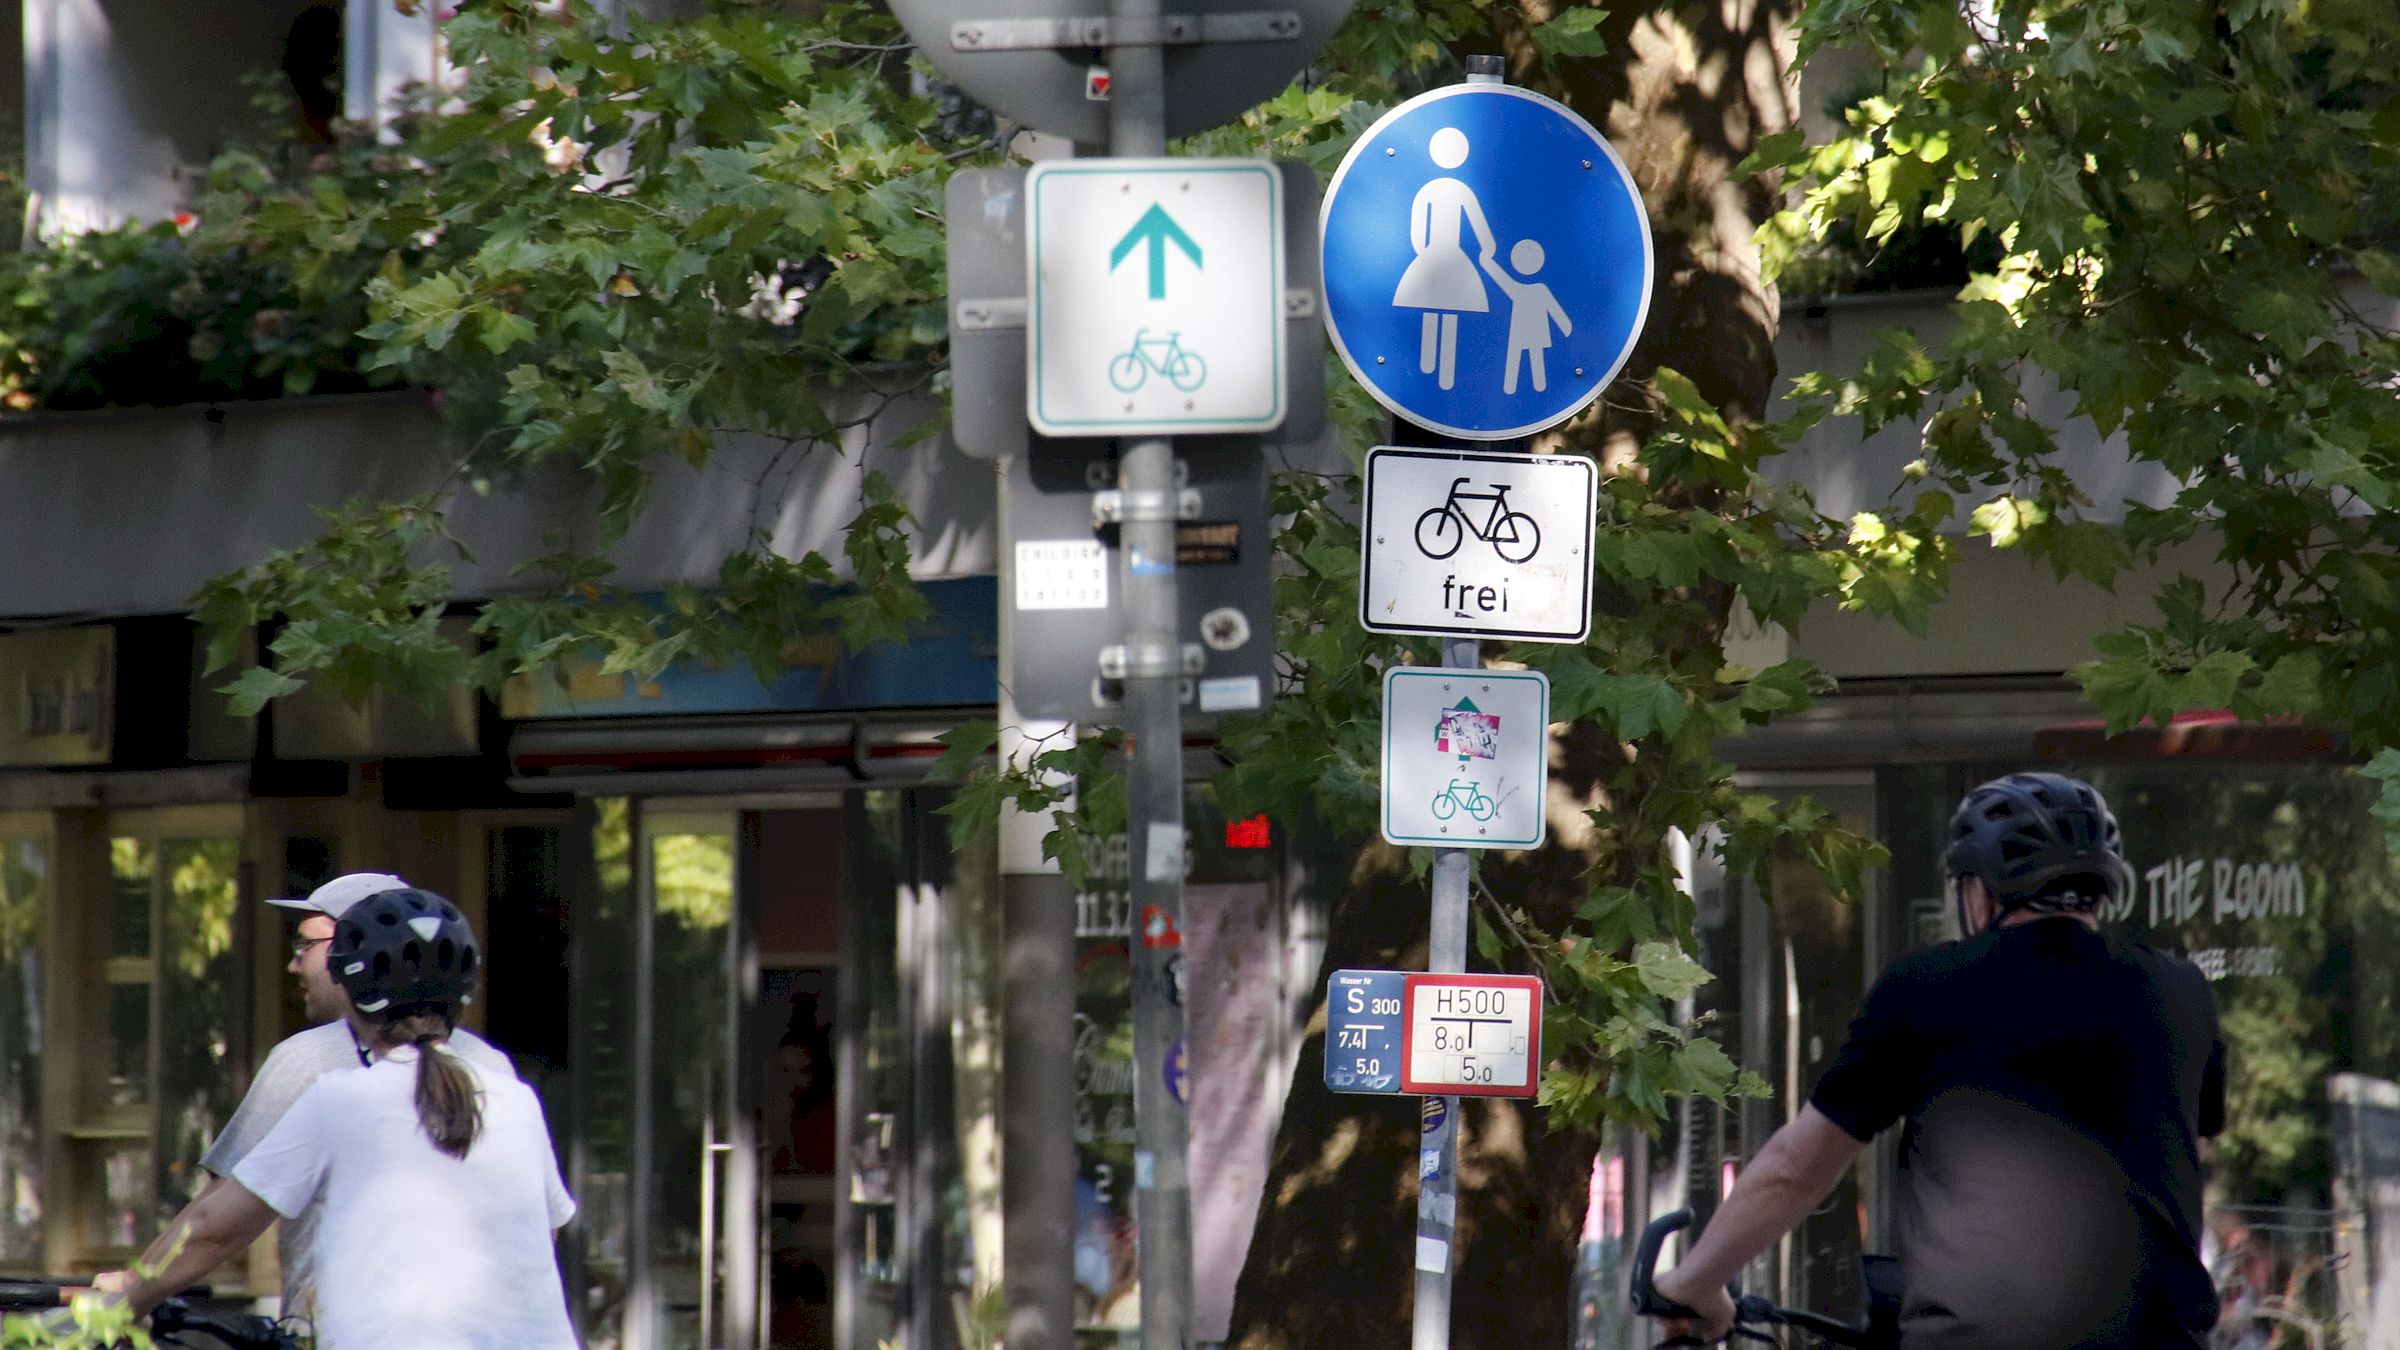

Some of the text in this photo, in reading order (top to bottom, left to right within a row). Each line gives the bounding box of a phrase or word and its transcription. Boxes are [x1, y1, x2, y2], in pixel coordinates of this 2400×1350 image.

[1443, 574, 1509, 613] frei
[2144, 855, 2205, 930] THE
[2213, 857, 2305, 926] ROOM
[1347, 987, 1401, 1016] S 300
[1356, 1058, 1380, 1076] 5,0
